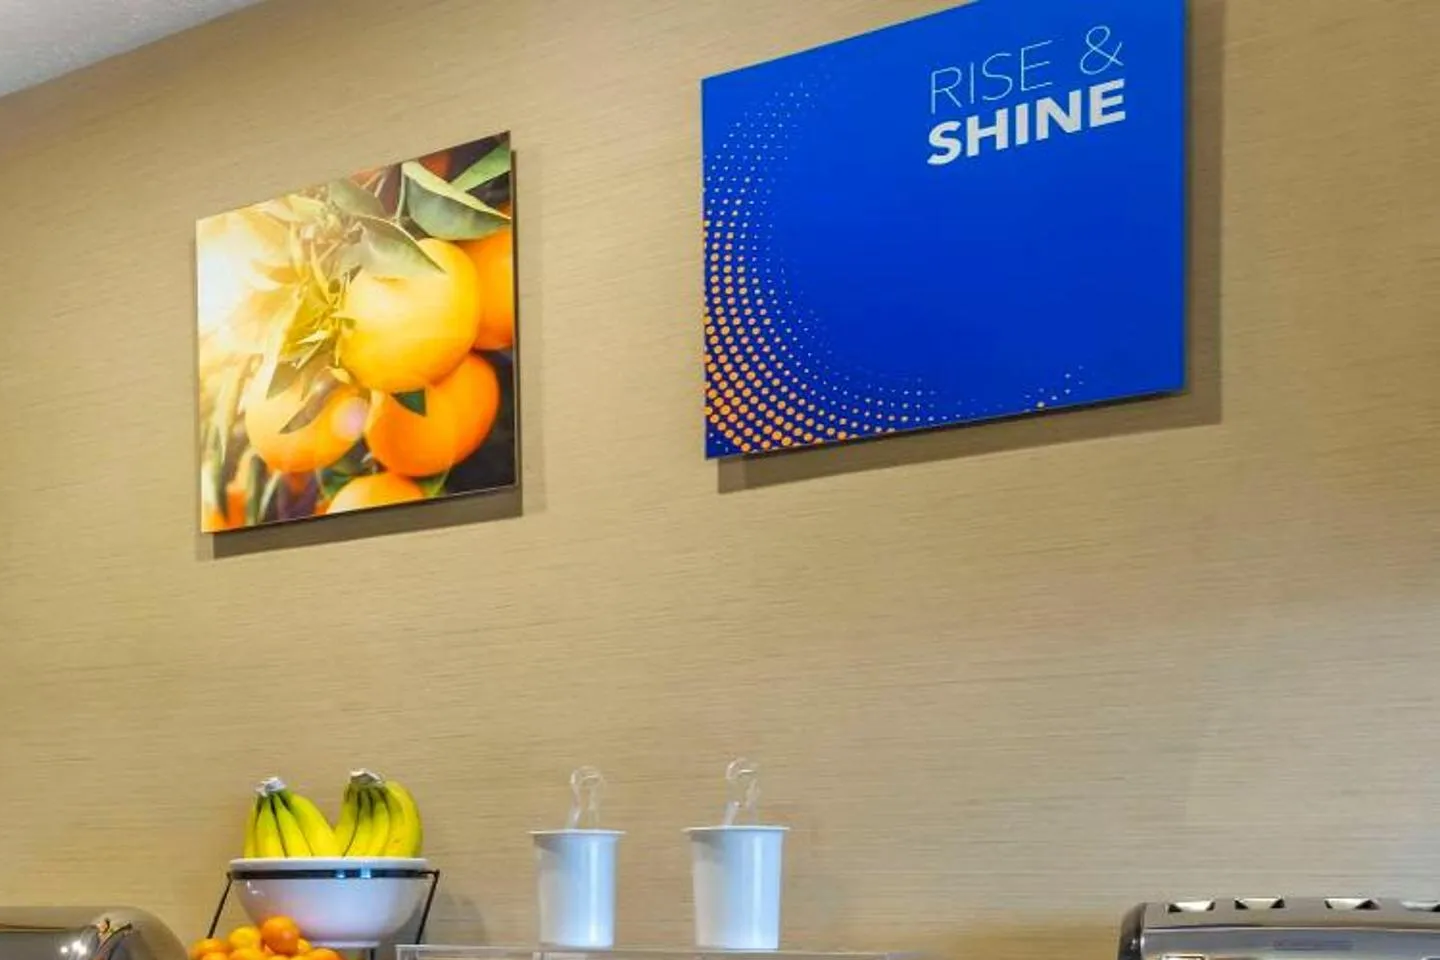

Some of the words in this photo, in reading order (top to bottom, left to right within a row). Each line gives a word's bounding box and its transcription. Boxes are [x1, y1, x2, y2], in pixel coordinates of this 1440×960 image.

[930, 39, 1053, 115] RISE
[1079, 25, 1124, 76] &
[927, 78, 1126, 166] SHINE
